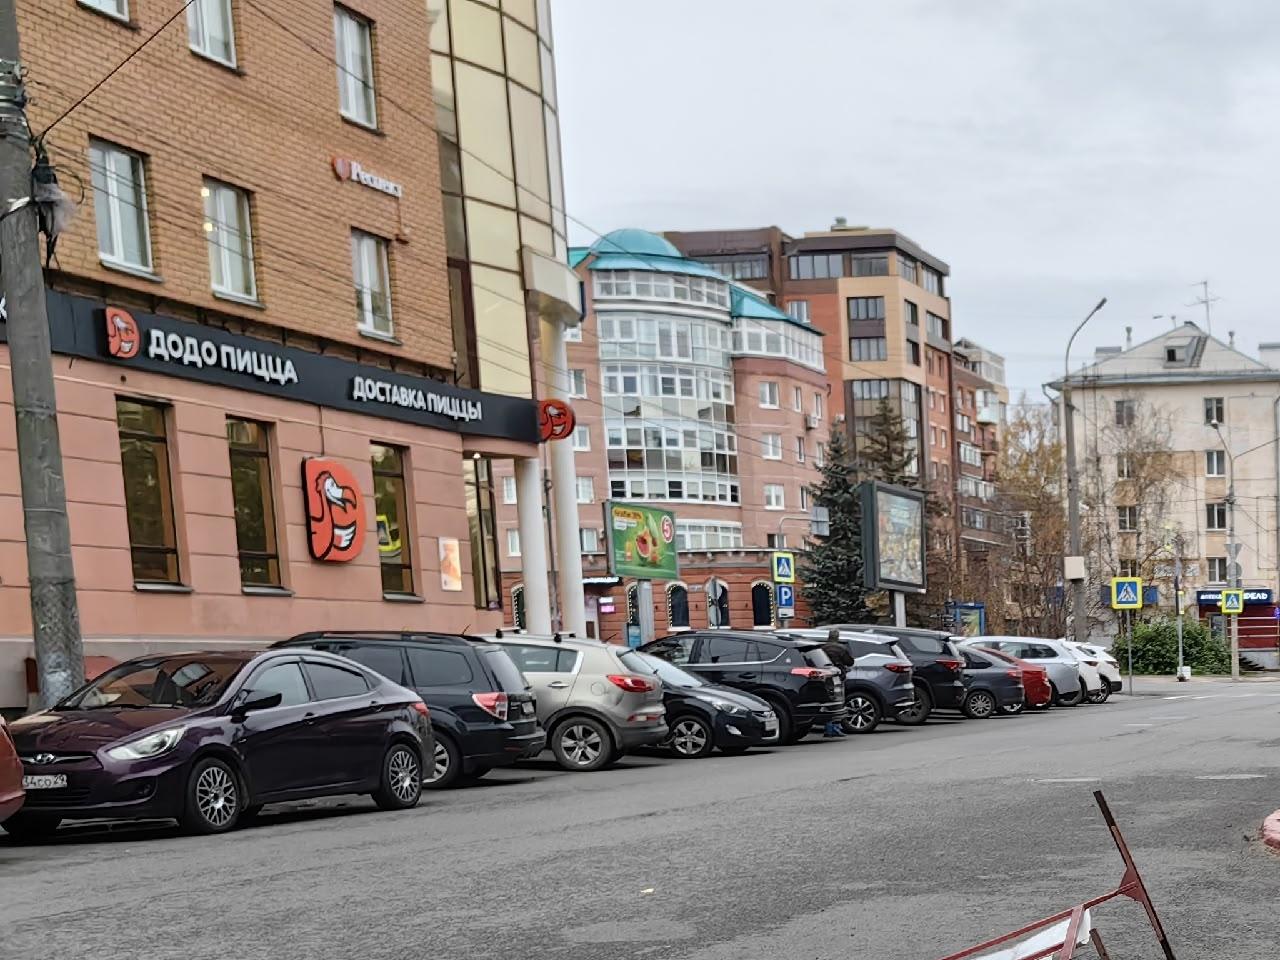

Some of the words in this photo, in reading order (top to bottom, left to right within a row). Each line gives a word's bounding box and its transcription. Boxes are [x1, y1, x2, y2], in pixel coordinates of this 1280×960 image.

[149, 328, 217, 368] ДОДО
[220, 344, 298, 385] ПИЦЦА
[353, 376, 427, 411] ДОСТАВКА
[427, 392, 482, 422] ПИЦЦЫ
[781, 587, 792, 605] P
